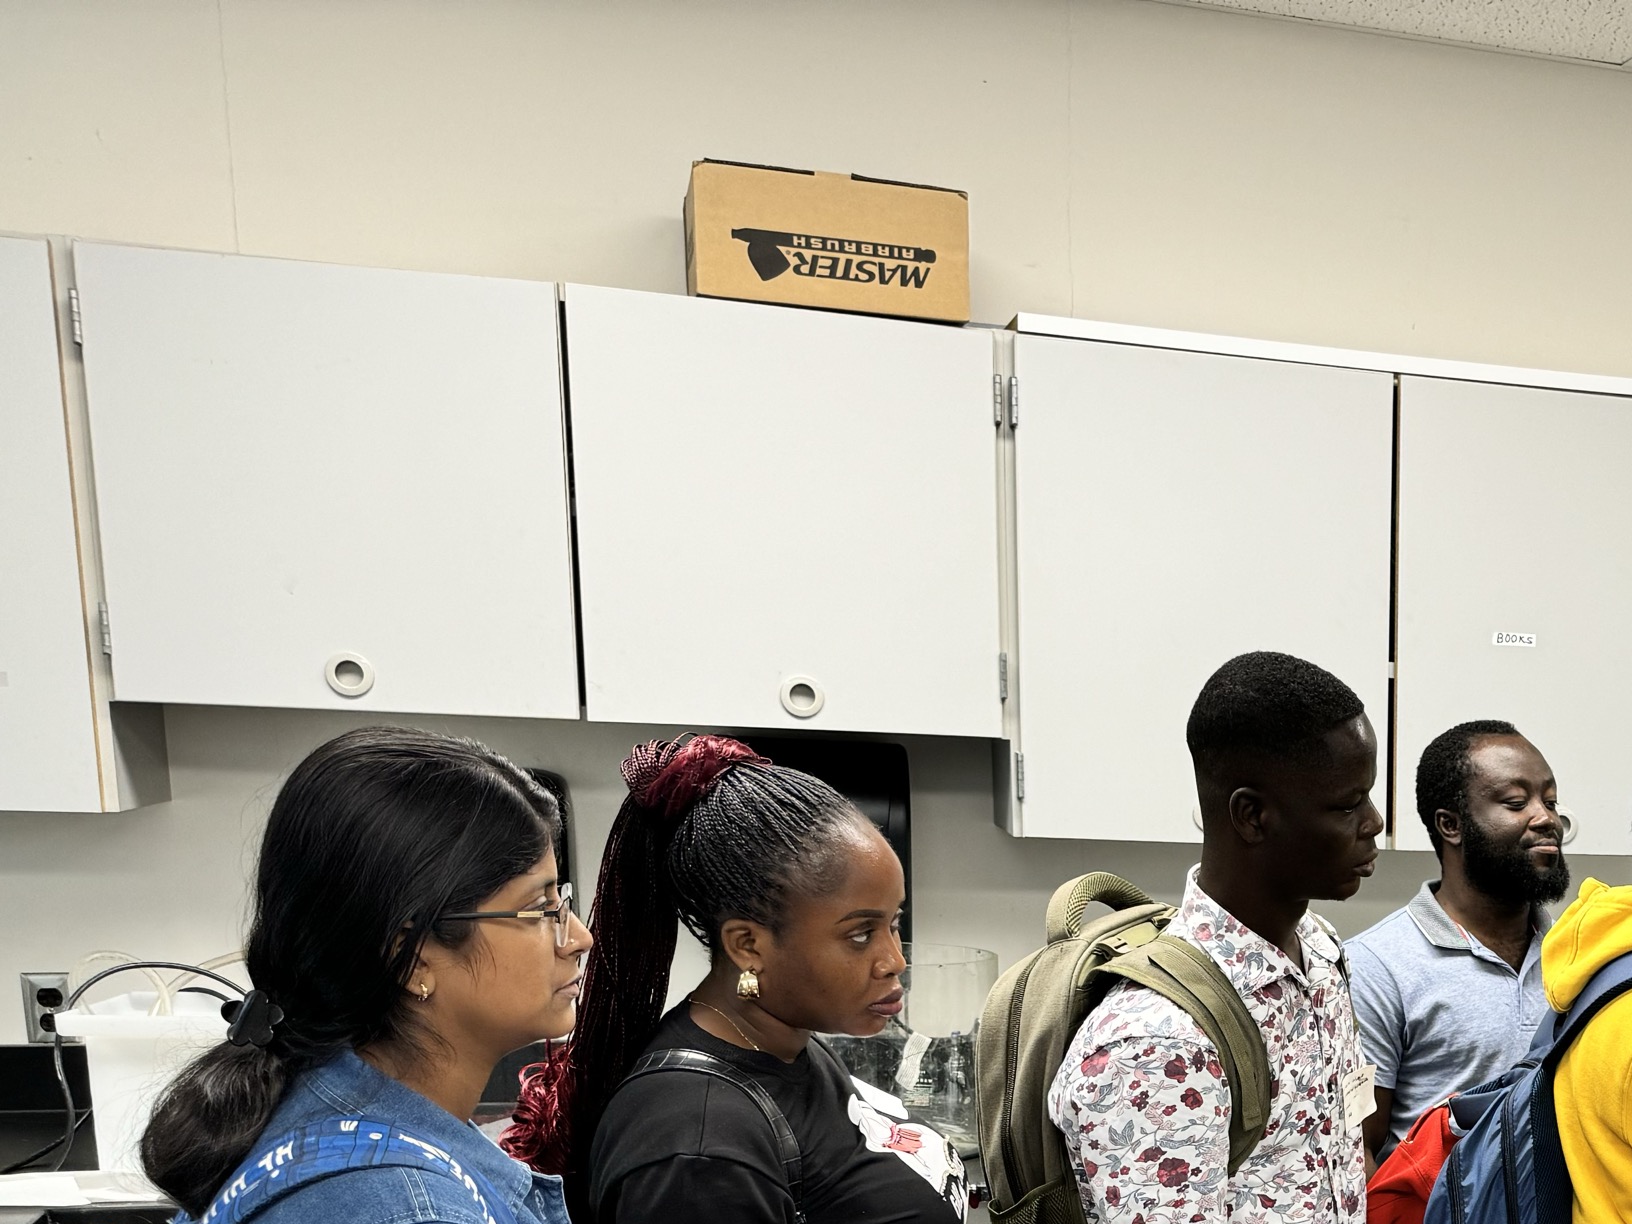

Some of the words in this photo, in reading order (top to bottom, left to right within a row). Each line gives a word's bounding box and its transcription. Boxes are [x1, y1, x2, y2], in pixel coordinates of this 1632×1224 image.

[793, 235, 915, 259] AIRBRUSH
[792, 251, 931, 289] MASTER
[1497, 632, 1534, 645] BOOKS
